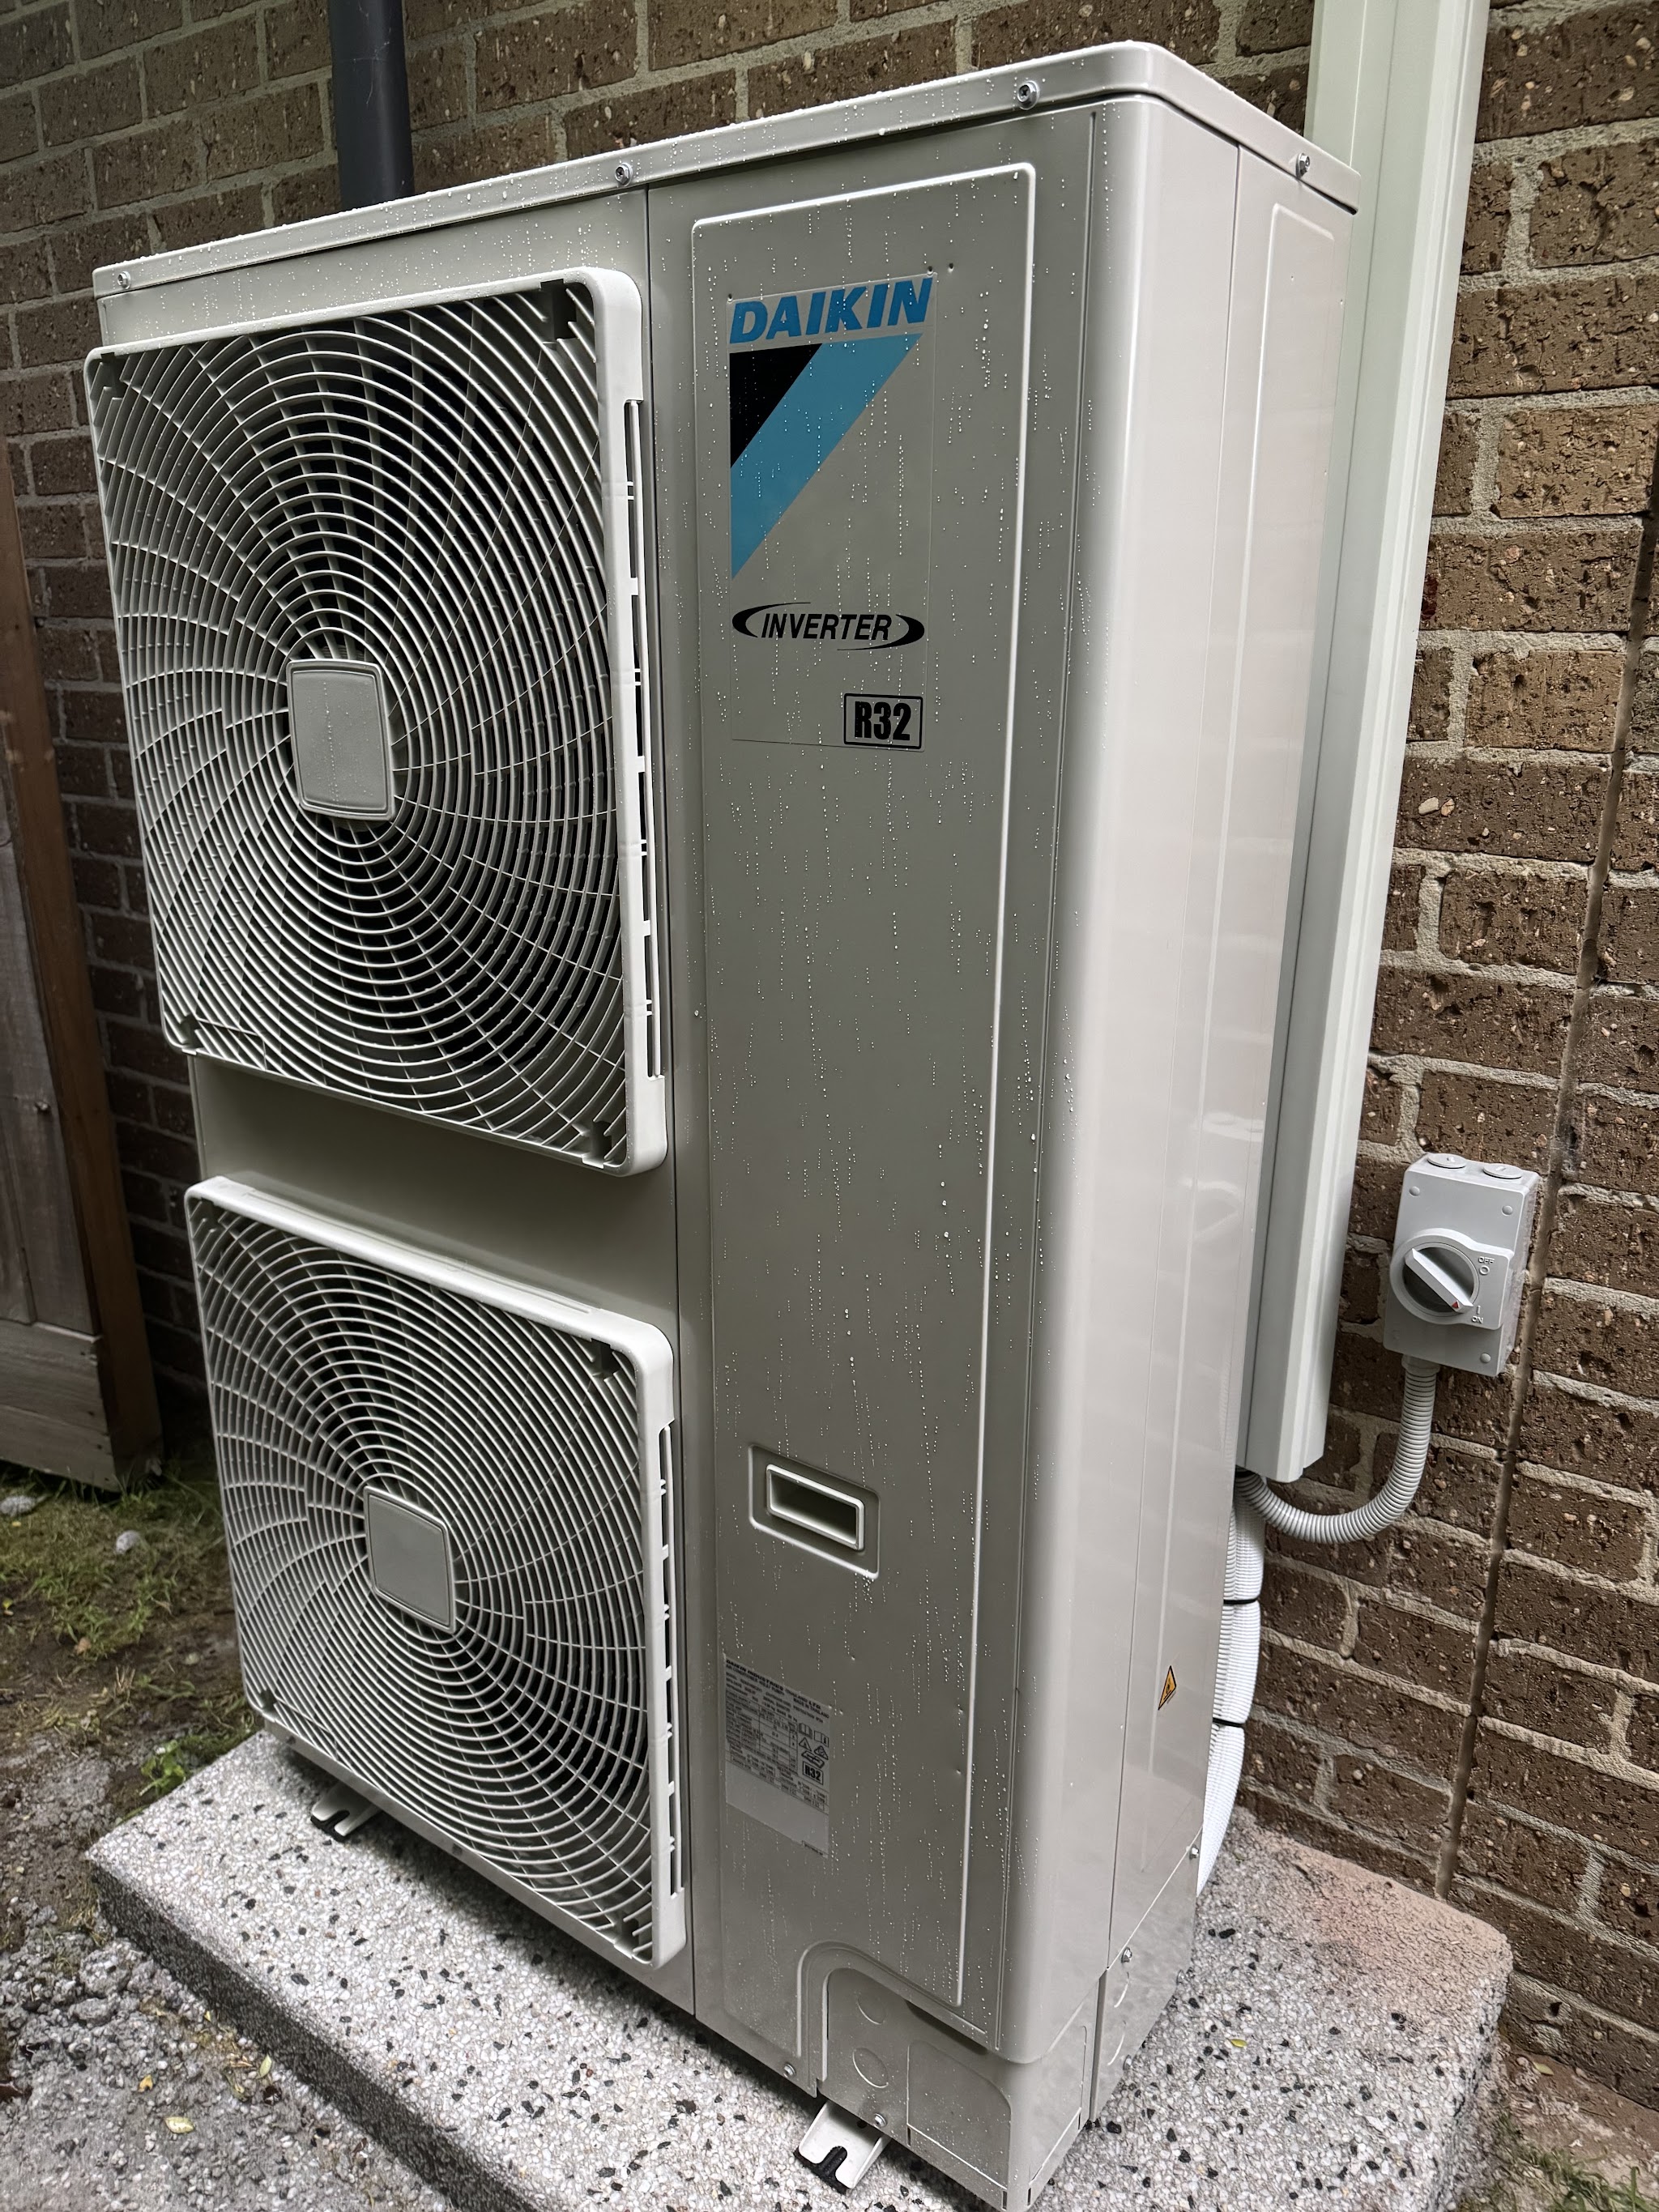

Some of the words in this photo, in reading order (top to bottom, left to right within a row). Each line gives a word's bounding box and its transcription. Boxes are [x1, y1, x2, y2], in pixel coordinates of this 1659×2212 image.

[730, 278, 932, 344] DAIKIN
[761, 613, 892, 640] INVERTER
[855, 701, 911, 741] R32
[1478, 1256, 1495, 1264] OFF
